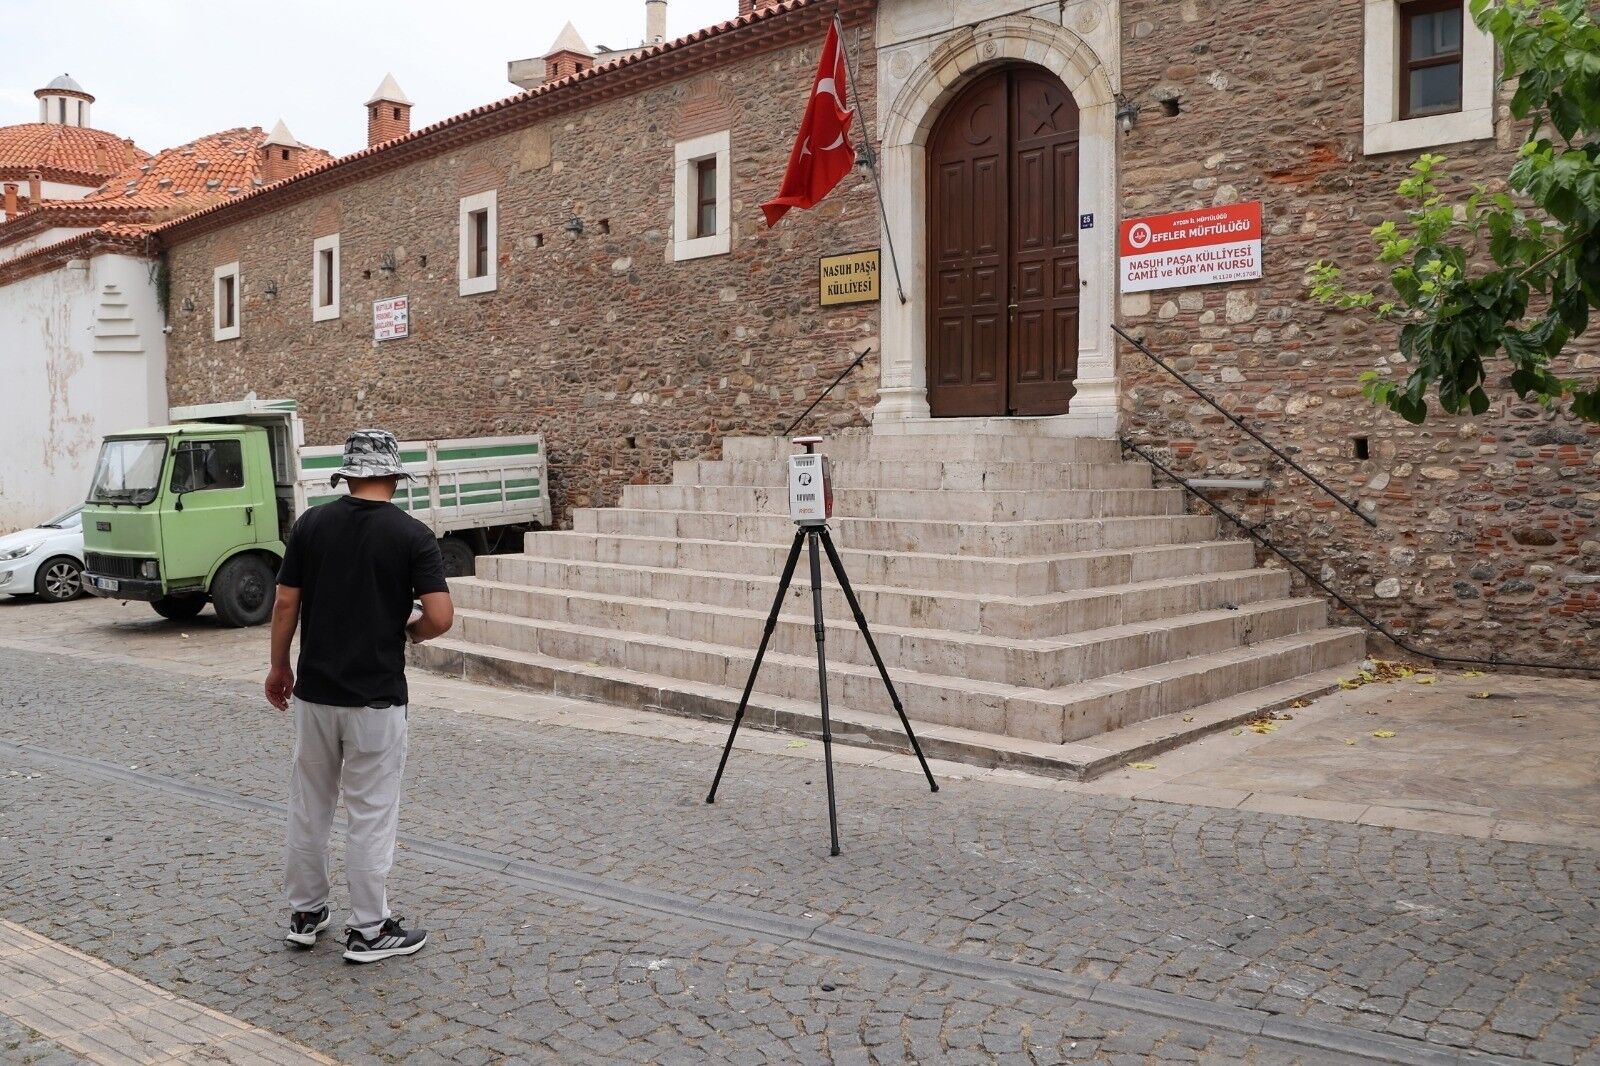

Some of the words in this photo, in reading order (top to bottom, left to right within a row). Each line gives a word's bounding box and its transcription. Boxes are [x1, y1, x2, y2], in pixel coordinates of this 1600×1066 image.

[1152, 229, 1187, 243] EFELER
[1188, 219, 1251, 238] MÜFTÜLÜĞÜ
[823, 263, 852, 278] NASUH
[854, 260, 876, 276] PAŞA
[1127, 269, 1159, 282] CAMİİ
[1161, 269, 1173, 278] ve
[1175, 263, 1214, 276] KUR'AN
[1217, 258, 1254, 271] KURSU
[1129, 258, 1164, 271] NASUH
[1166, 254, 1193, 266] PAŞA
[1195, 245, 1252, 262] KÜLLİYESİ
[827, 276, 872, 296] KÜLLİYESİ
